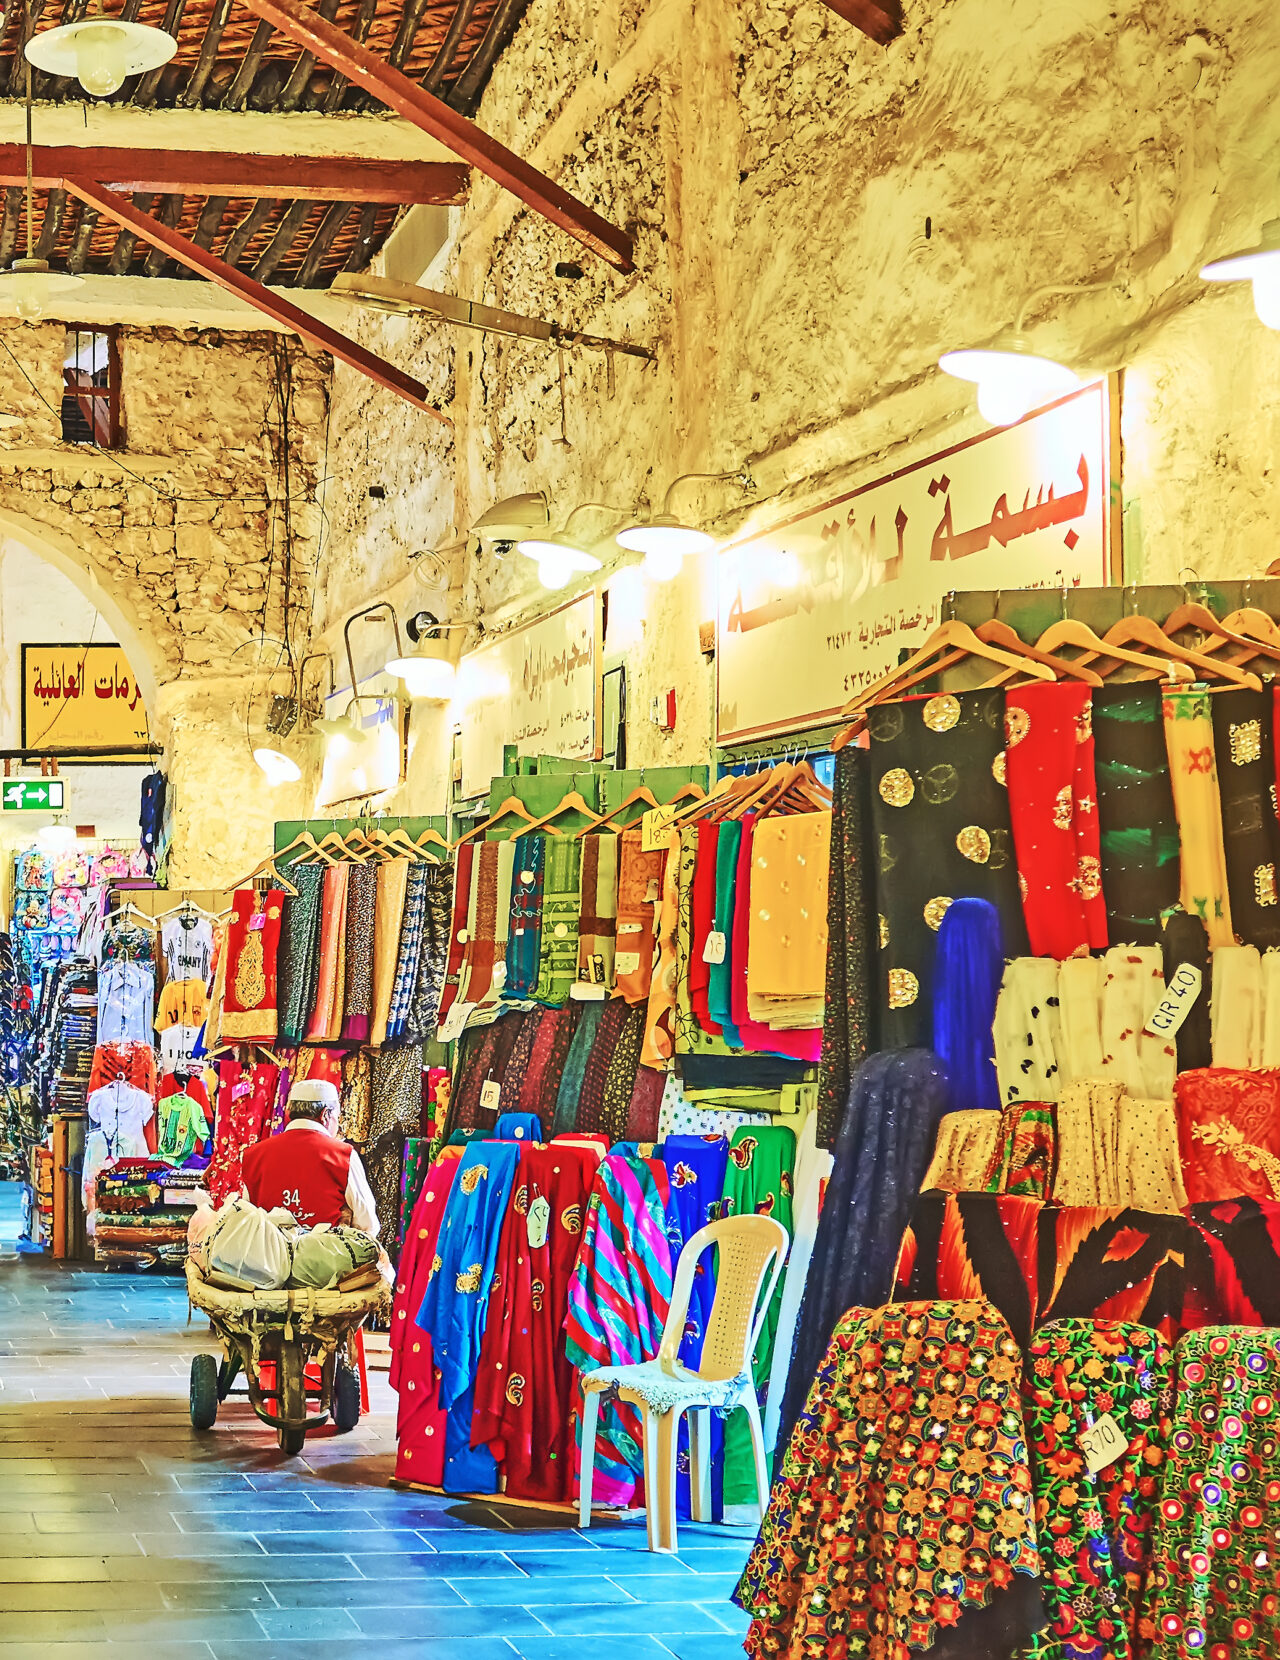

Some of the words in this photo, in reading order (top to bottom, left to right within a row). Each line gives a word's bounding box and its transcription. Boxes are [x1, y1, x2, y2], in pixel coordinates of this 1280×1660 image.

[929, 453, 1090, 562] بسمة
[858, 613, 896, 650] التجارية
[899, 602, 938, 631] الرخصة
[33, 660, 85, 707] العائلية
[94, 660, 144, 712] زمات
[1152, 1001, 1179, 1030] QR
[1170, 970, 1196, 998] 40
[483, 1090, 494, 1103] 15
[282, 1189, 300, 1207] 34
[293, 1207, 315, 1220] سوق
